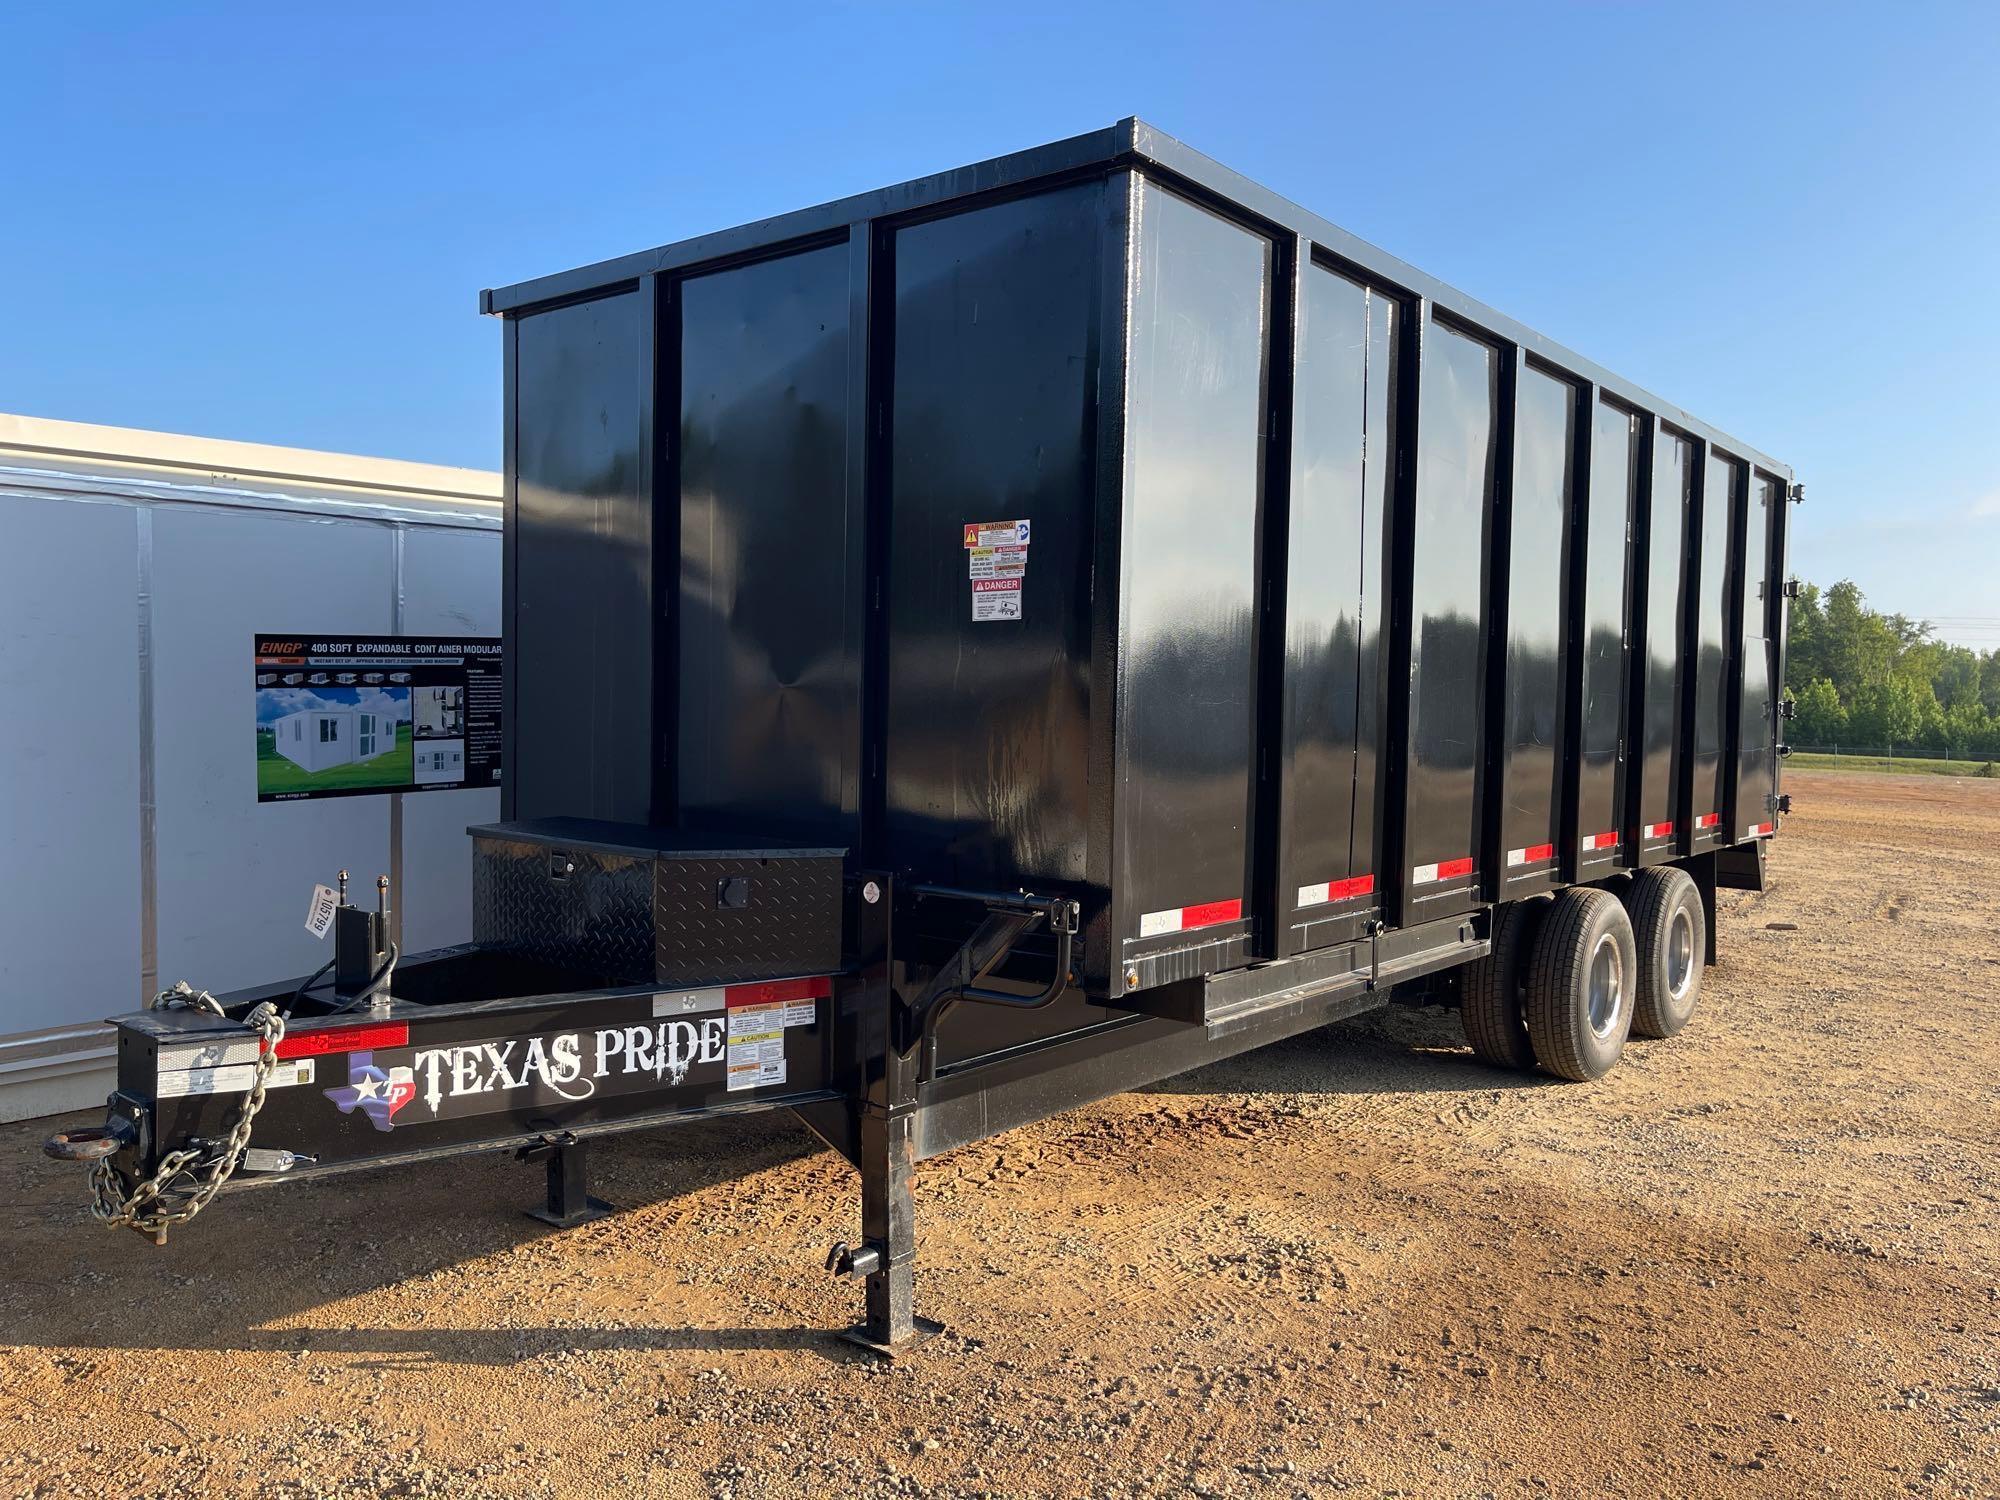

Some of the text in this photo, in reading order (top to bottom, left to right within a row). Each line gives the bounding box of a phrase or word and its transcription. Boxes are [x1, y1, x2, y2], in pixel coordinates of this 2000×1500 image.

[986, 522, 1013, 530] WARNING
[984, 580, 1018, 590] DANGER
[259, 642, 302, 654] EINGP
[311, 643, 328, 653] 400
[356, 644, 411, 654] EXPANDABLE
[463, 645, 502, 655] MODULAR
[314, 898, 334, 932] 105799
[414, 1017, 726, 1117] TEXAS PRIDE
[382, 1078, 408, 1105] TP
